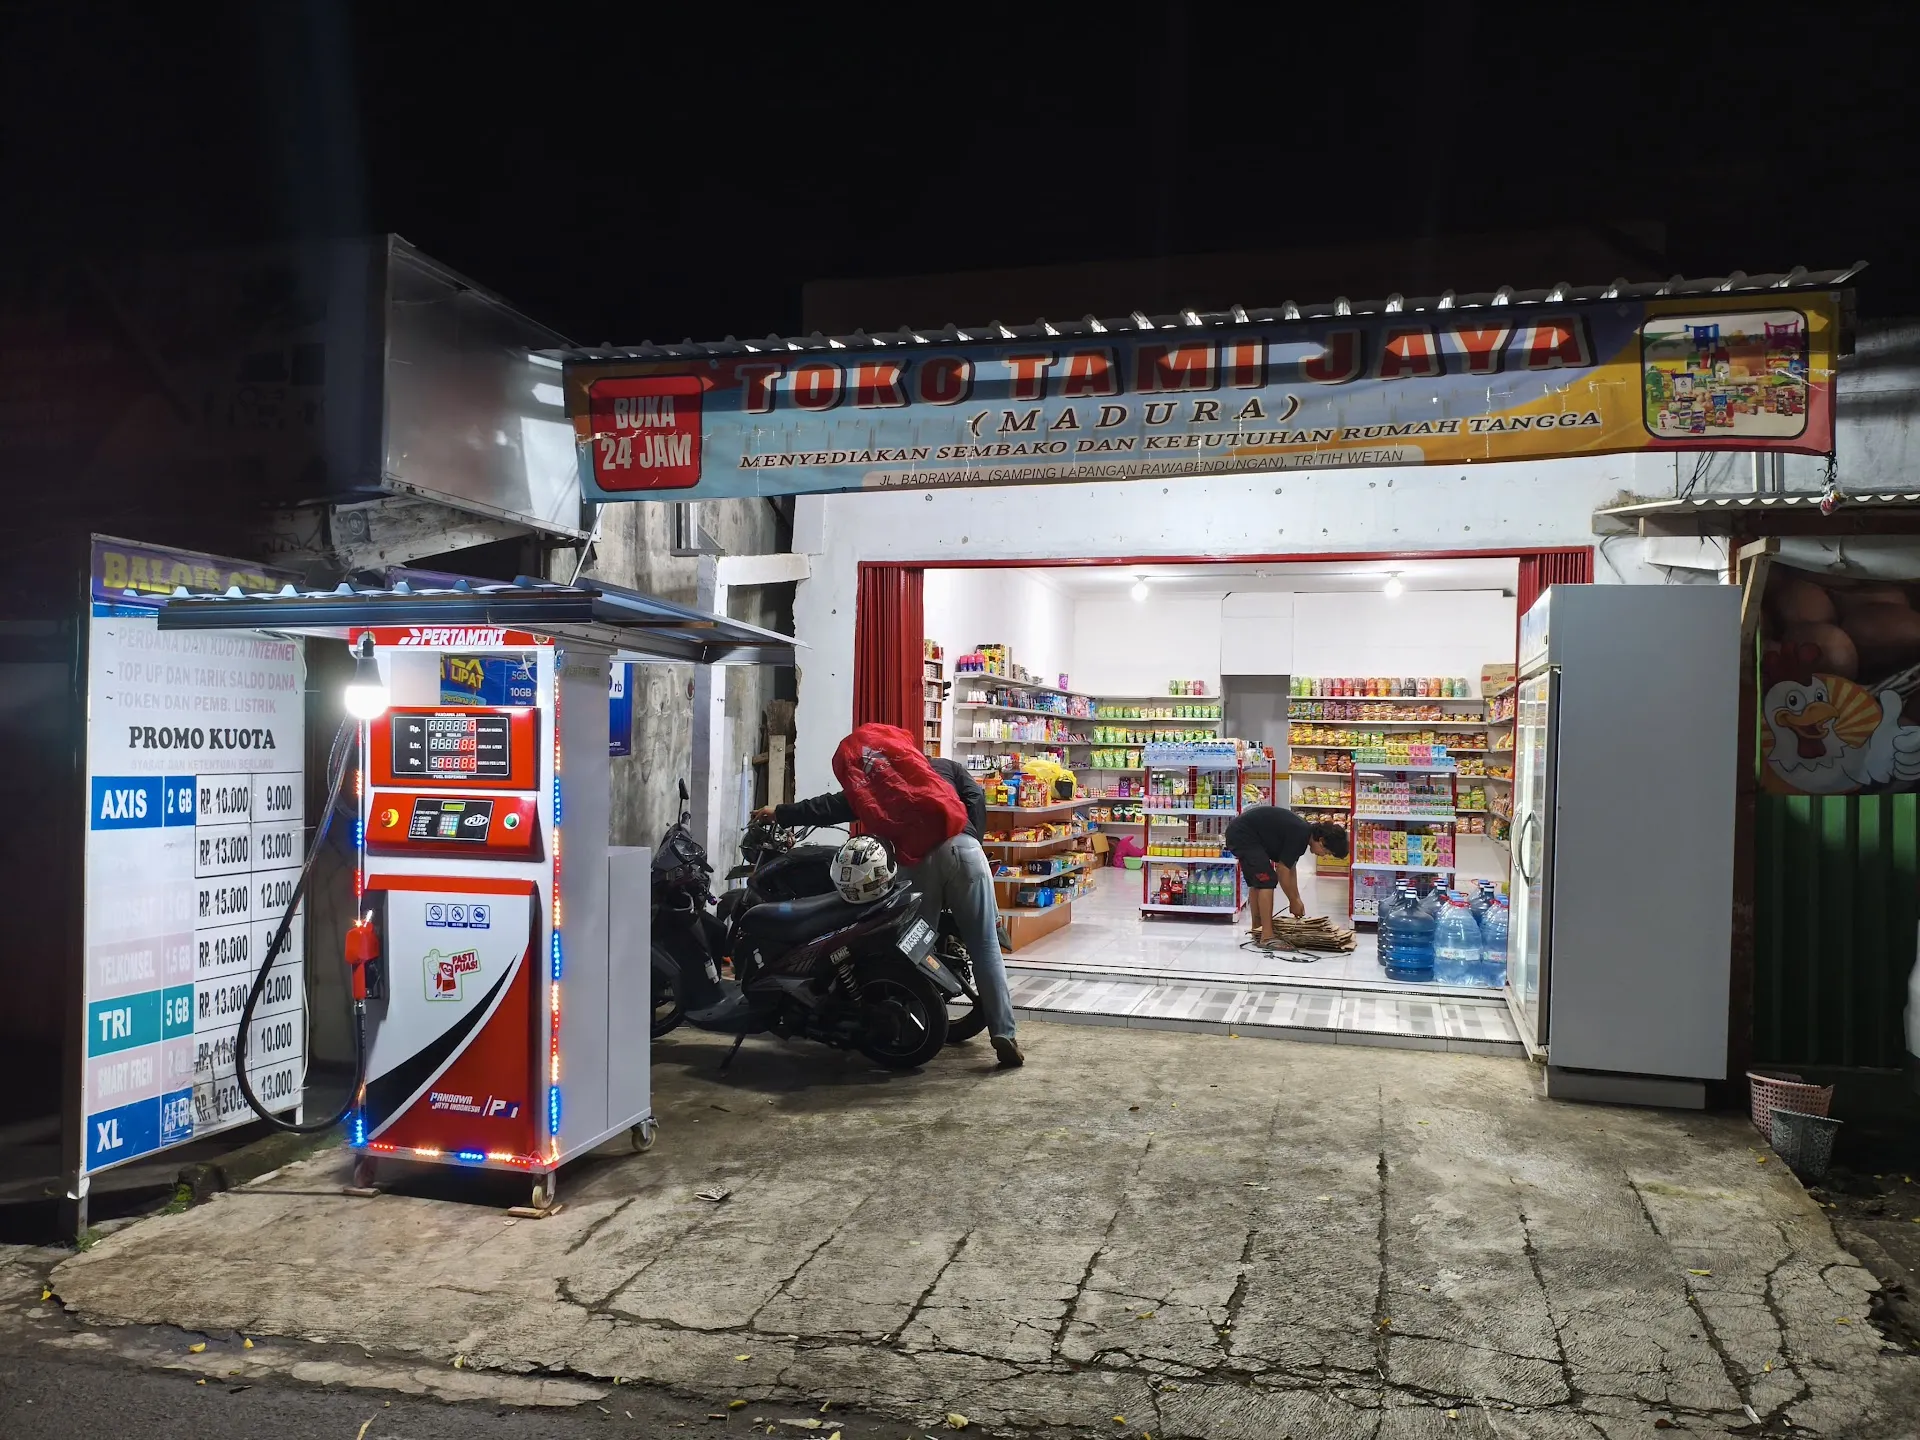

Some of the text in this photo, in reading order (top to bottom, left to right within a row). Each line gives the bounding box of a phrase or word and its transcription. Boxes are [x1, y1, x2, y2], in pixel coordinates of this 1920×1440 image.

[735, 317, 1598, 414] TOKO TAMI JAYA
[613, 395, 676, 430] BUKA
[601, 434, 692, 471] 24 JAM
[739, 411, 1602, 468] MENYEDIAKAN SEMBAKO DAN KEBUTUHAN RUMAH TANGGA
[879, 474, 895, 486] JL.
[988, 467, 1056, 483] (SAMPING
[1061, 463, 1138, 479] LAPANGAN
[1347, 450, 1404, 464] WETAN
[182, 635, 208, 654] DAN
[209, 638, 247, 657] KUOTA
[247, 641, 297, 662] INTERNET
[420, 628, 507, 646] PERTAMINI
[117, 661, 143, 682] TOP
[145, 663, 162, 683] UP
[166, 665, 191, 686] DAN
[194, 668, 227, 688] TARIK
[229, 671, 265, 690] SALDO
[451, 664, 485, 689] LIPAT
[511, 671, 529, 681] 5GB
[614, 680, 622, 693] rb
[117, 691, 277, 714] TOKEN DAN PEMB. LISTRIK
[510, 687, 532, 698] 10GB
[128, 726, 277, 750] PROMO KUOTA
[409, 725, 421, 733] Rp.
[409, 757, 421, 765] Rp.
[100, 789, 148, 820] AXIS
[167, 789, 174, 814] 2
[178, 788, 192, 813] GB
[215, 786, 249, 814] 10.000
[266, 785, 292, 811] 9.000
[215, 835, 249, 864] 13.000
[260, 832, 292, 860] 13.000
[215, 886, 248, 916] 15.000
[260, 880, 292, 909] 12.000
[215, 935, 248, 966] 10.000
[452, 951, 475, 965] PASTI
[454, 960, 478, 973] PUAS!
[98, 1006, 132, 1042] TRI
[166, 1002, 172, 1027] 5
[174, 996, 189, 1024] GB
[215, 984, 248, 1016] 13.000
[261, 974, 292, 1006] 12.000
[261, 1021, 292, 1053] 10.000
[96, 1118, 124, 1154] XL
[261, 1069, 292, 1102] 13.000
[430, 1091, 473, 1105] PANDAWA
[431, 1102, 481, 1113] JAYA INDONESIA
